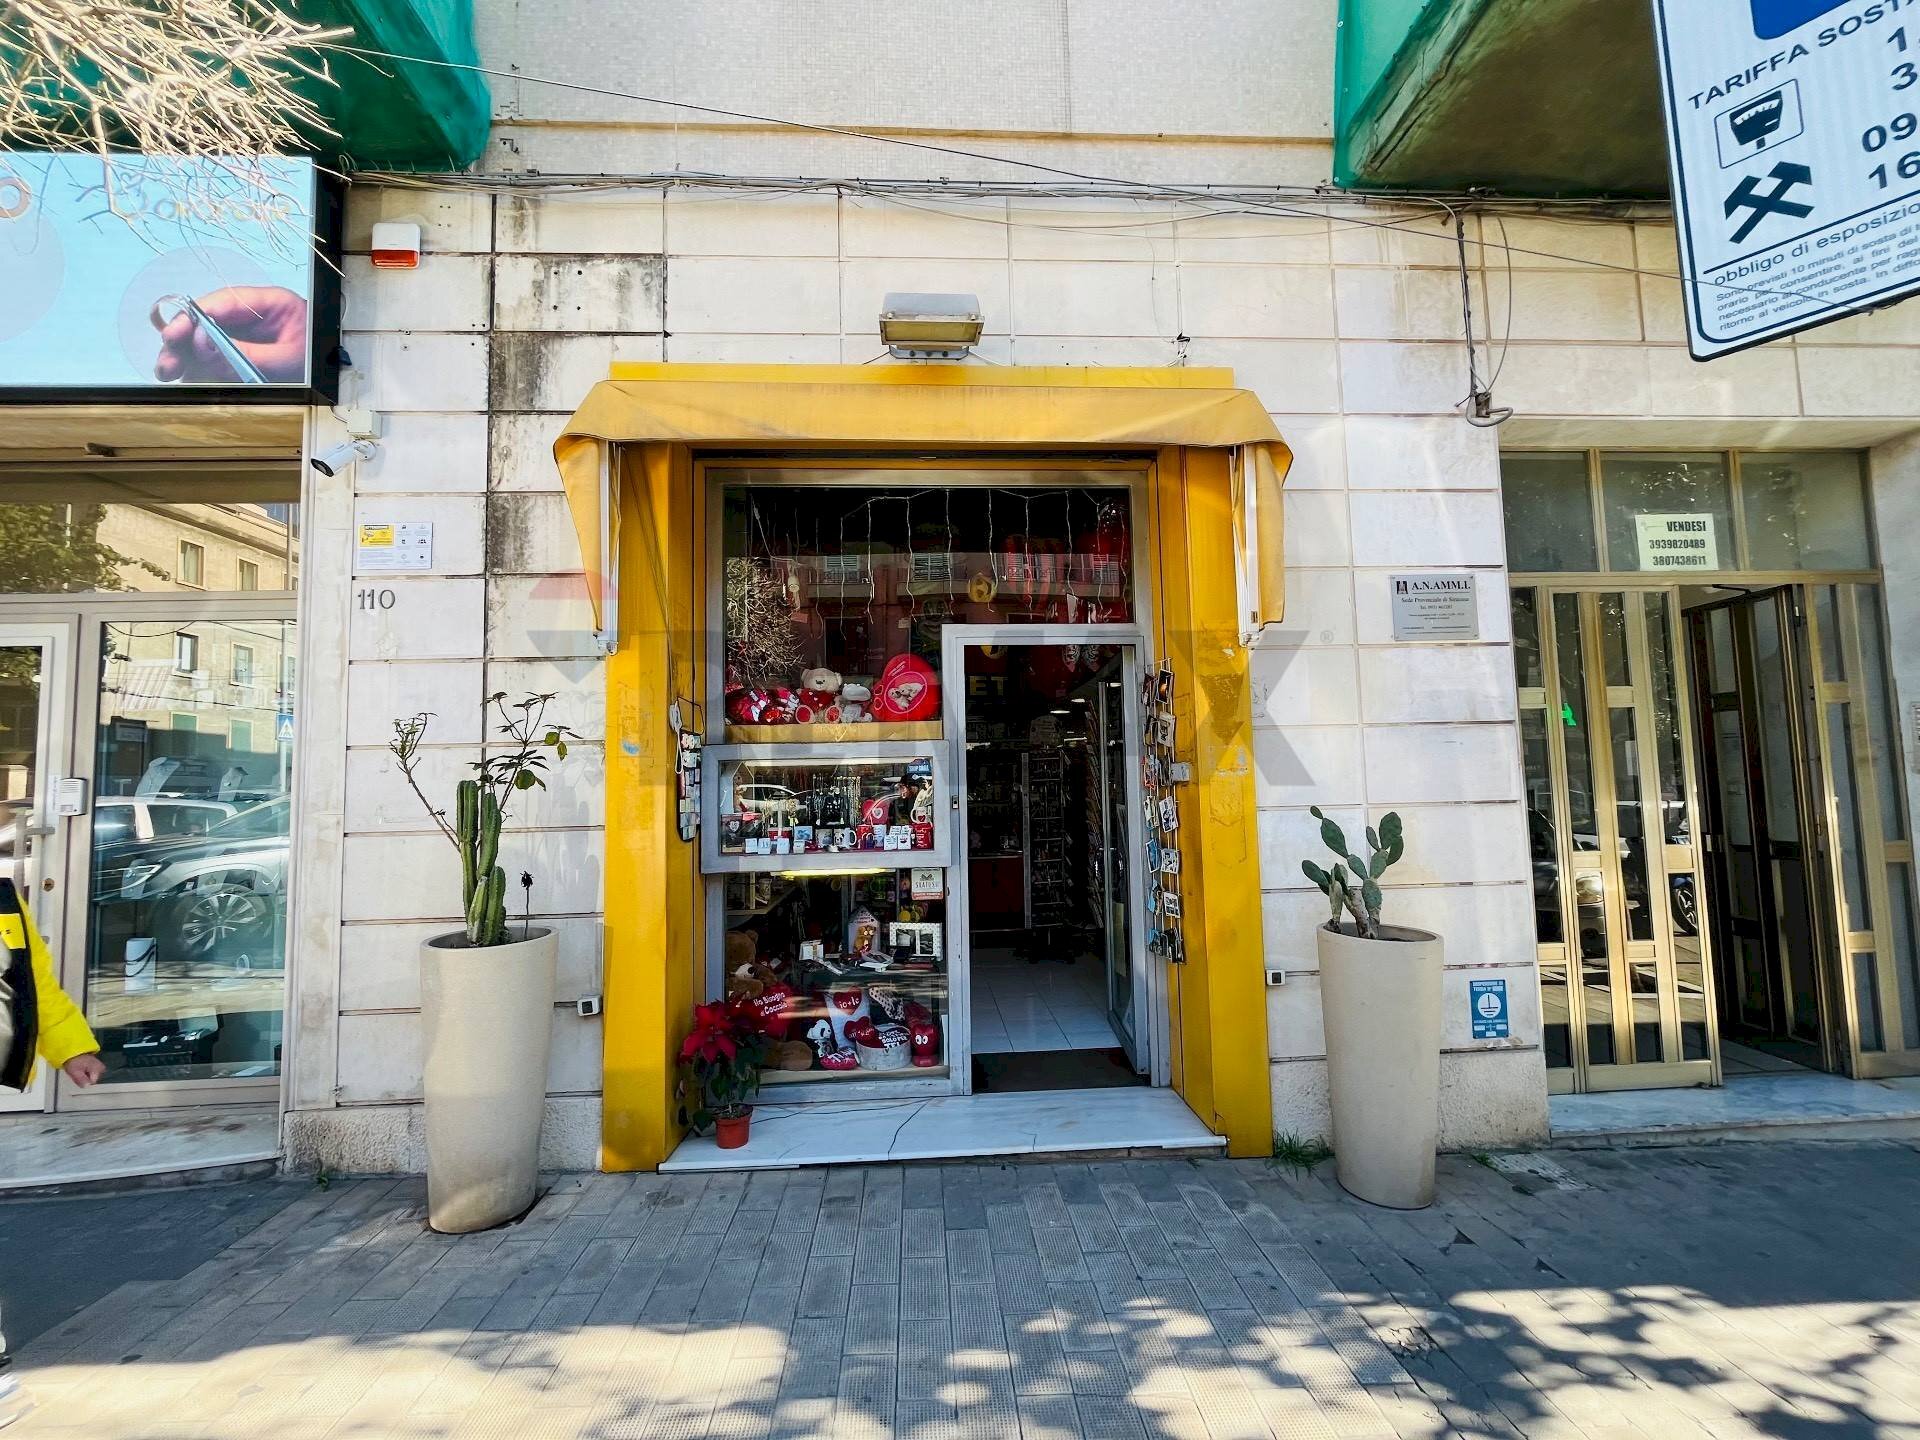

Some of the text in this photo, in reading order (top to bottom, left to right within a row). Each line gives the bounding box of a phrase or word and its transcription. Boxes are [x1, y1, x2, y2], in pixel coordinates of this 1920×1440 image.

[1688, 0, 1914, 109] TARIFFA SOST
[1862, 112, 1918, 153] 09
[1868, 150, 1920, 190] 16
[1714, 202, 1920, 287] obbligo di esposizio
[1716, 289, 1745, 301] Sono
[1747, 271, 1788, 291] previsti
[1792, 265, 1805, 275] 10
[1808, 251, 1845, 268] minuti
[1847, 246, 1858, 255] di
[1861, 233, 1897, 250] sosta
[1717, 296, 1749, 311] orario
[1719, 296, 1778, 320] necessario
[1796, 266, 1867, 294] conducente
[1720, 315, 1754, 331] ritorno
[1666, 521, 1706, 531] VENDESI
[357, 588, 396, 610] 110
